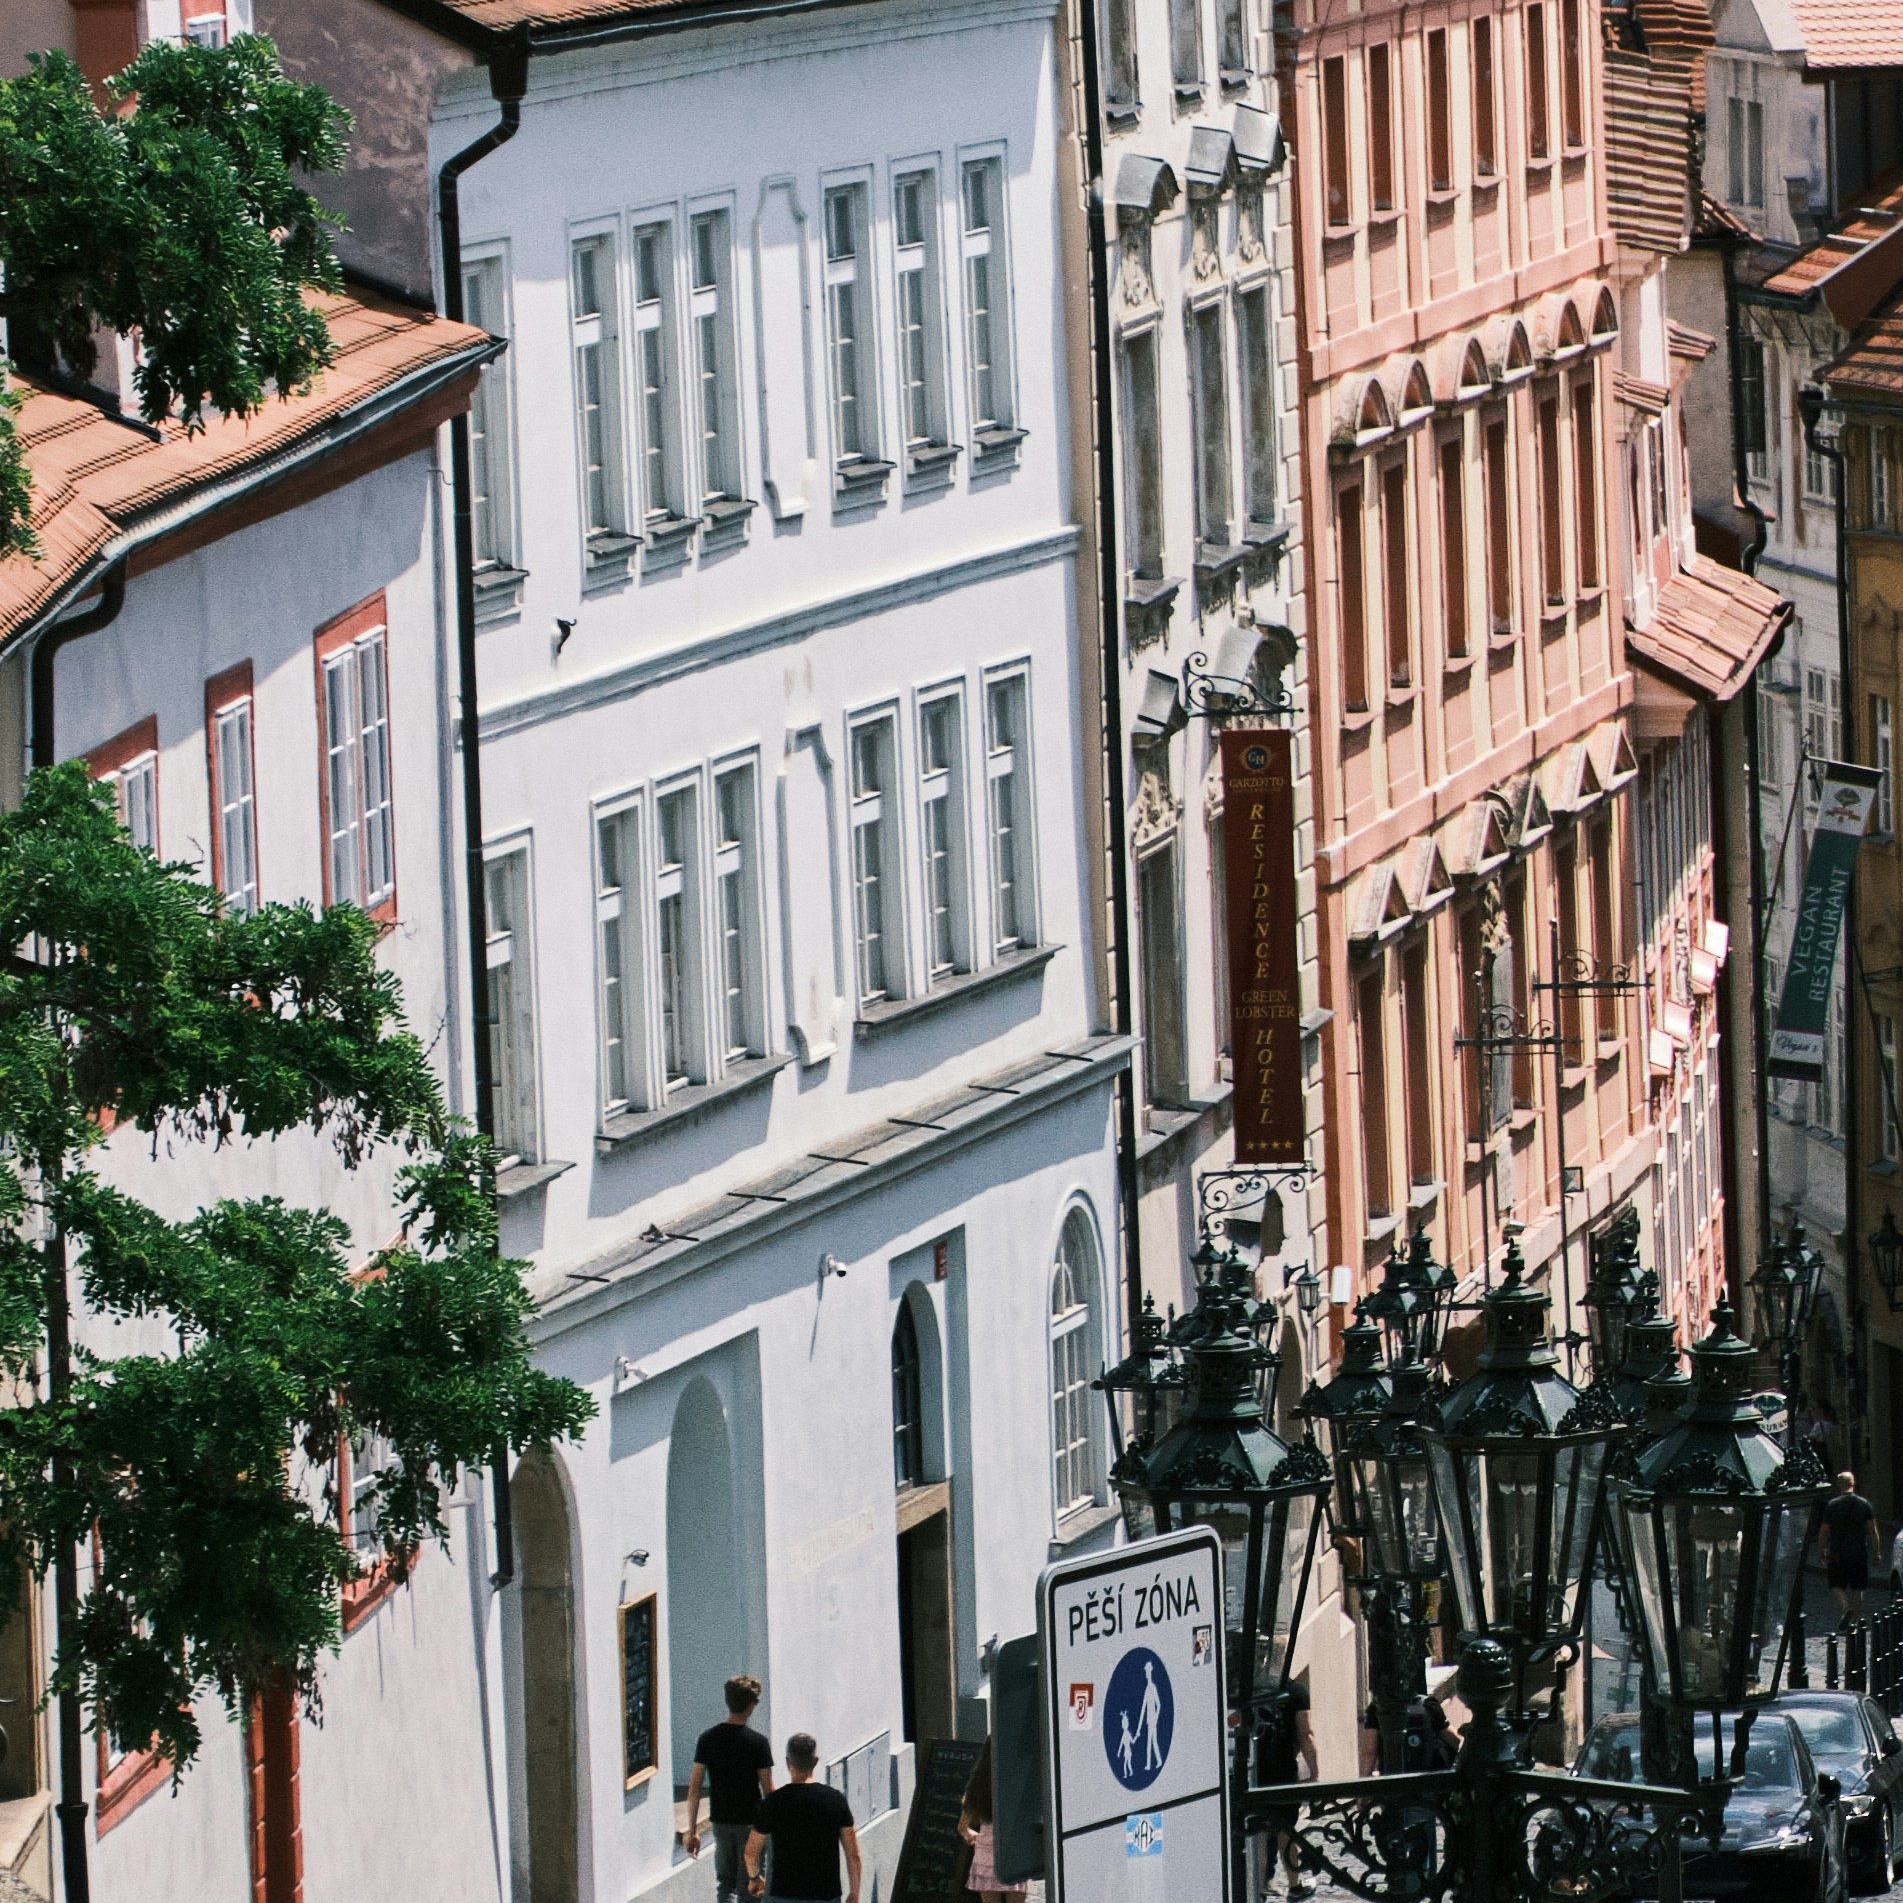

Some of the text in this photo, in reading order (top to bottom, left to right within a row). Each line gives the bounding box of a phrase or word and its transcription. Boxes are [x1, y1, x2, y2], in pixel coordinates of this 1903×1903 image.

[1249, 803, 1270, 979] RESIDENCE
[1791, 885, 1822, 976] VEGAN
[1808, 865, 1850, 1002] RESTAURANT
[1235, 1006, 1296, 1019] LOBSTER
[1241, 990, 1288, 1003] GREEN
[1256, 1029, 1275, 1125] HOTEL
[1069, 1572, 1200, 1647] PĚŠÍ ZÓNA
